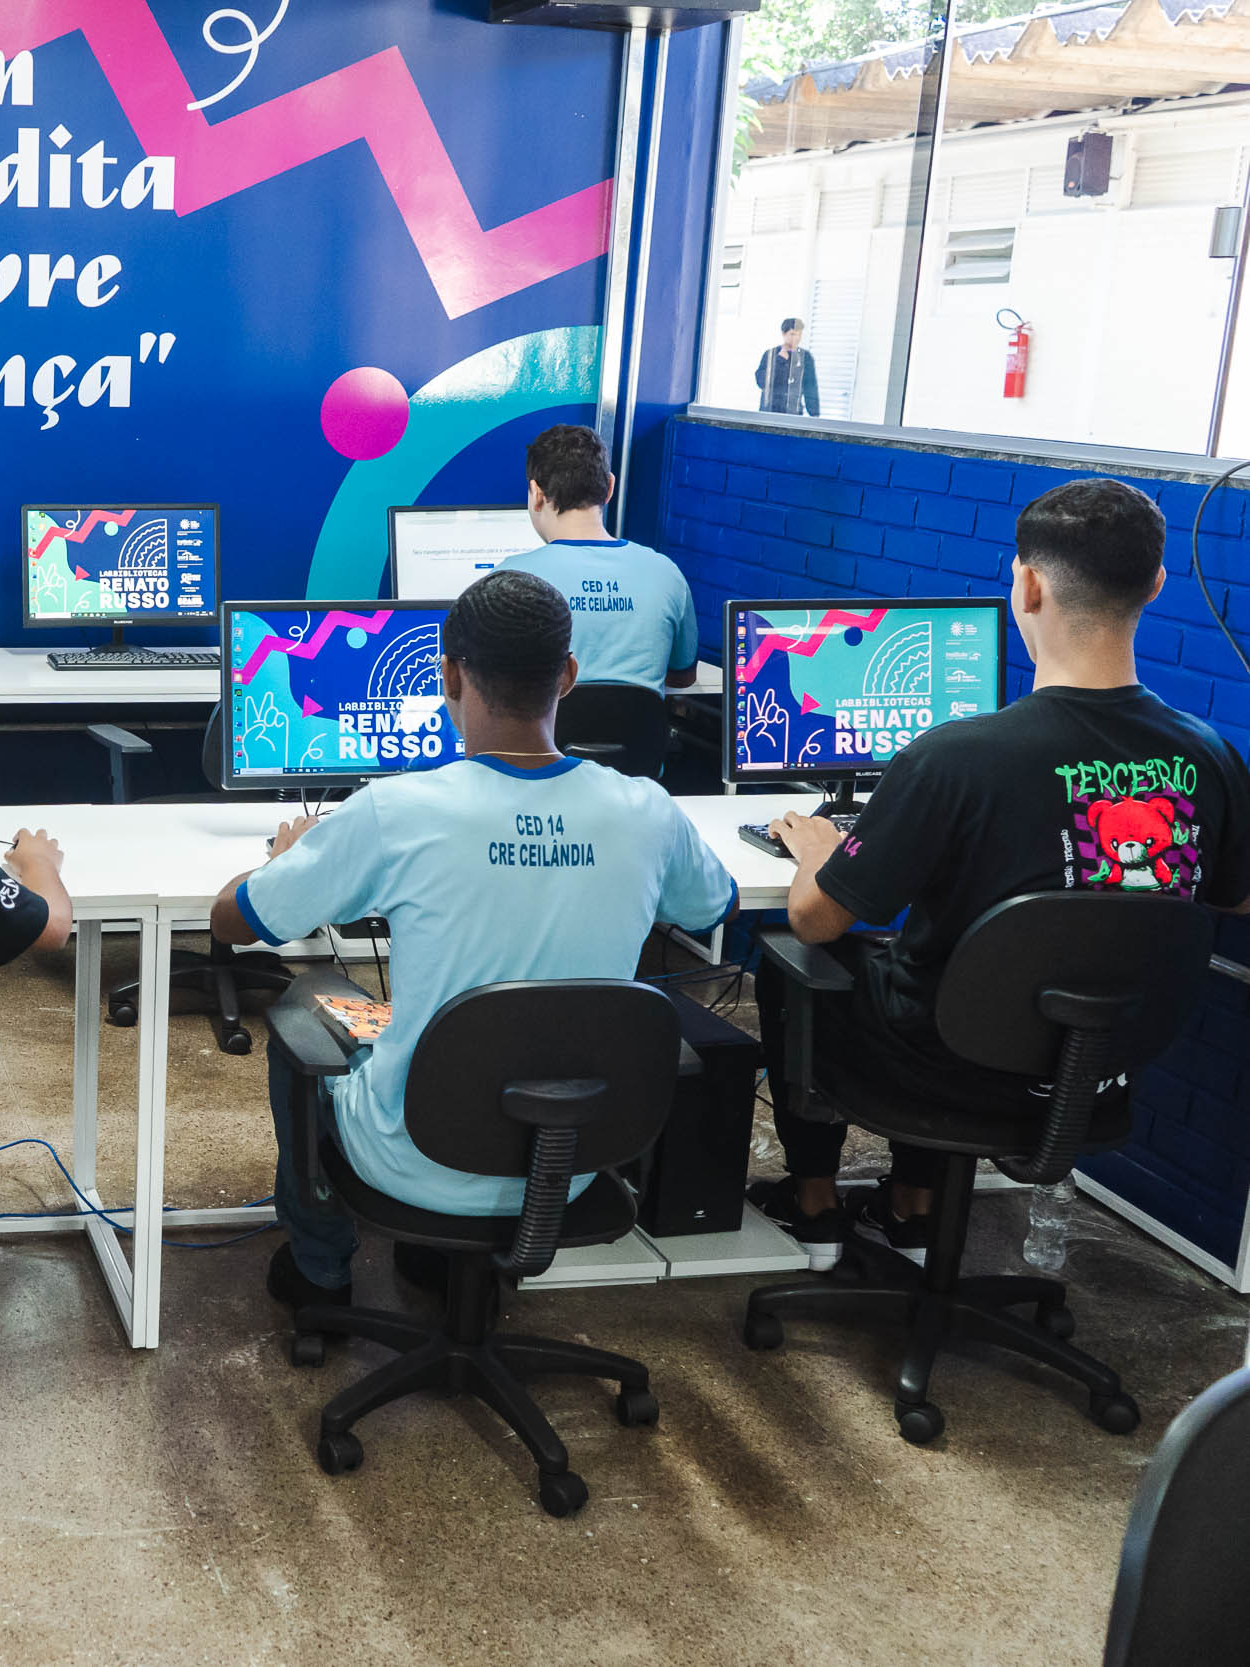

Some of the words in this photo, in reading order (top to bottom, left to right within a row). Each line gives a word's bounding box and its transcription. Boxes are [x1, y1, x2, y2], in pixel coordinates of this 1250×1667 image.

[99, 577, 170, 592] RENATO
[581, 580, 603, 593] CED
[606, 580, 619, 593] 14
[99, 592, 170, 609] RUSSO
[569, 596, 587, 611] CRE
[588, 594, 634, 612] CEILÂNDIA
[338, 712, 443, 735] RENAO
[835, 708, 934, 730] RENATO
[338, 734, 443, 760] RUSSO
[835, 730, 927, 755] RUSS
[516, 814, 543, 836] CED
[547, 814, 564, 836] 14
[488, 841, 516, 866] CRE
[519, 839, 596, 867] CEILÂNDIA
